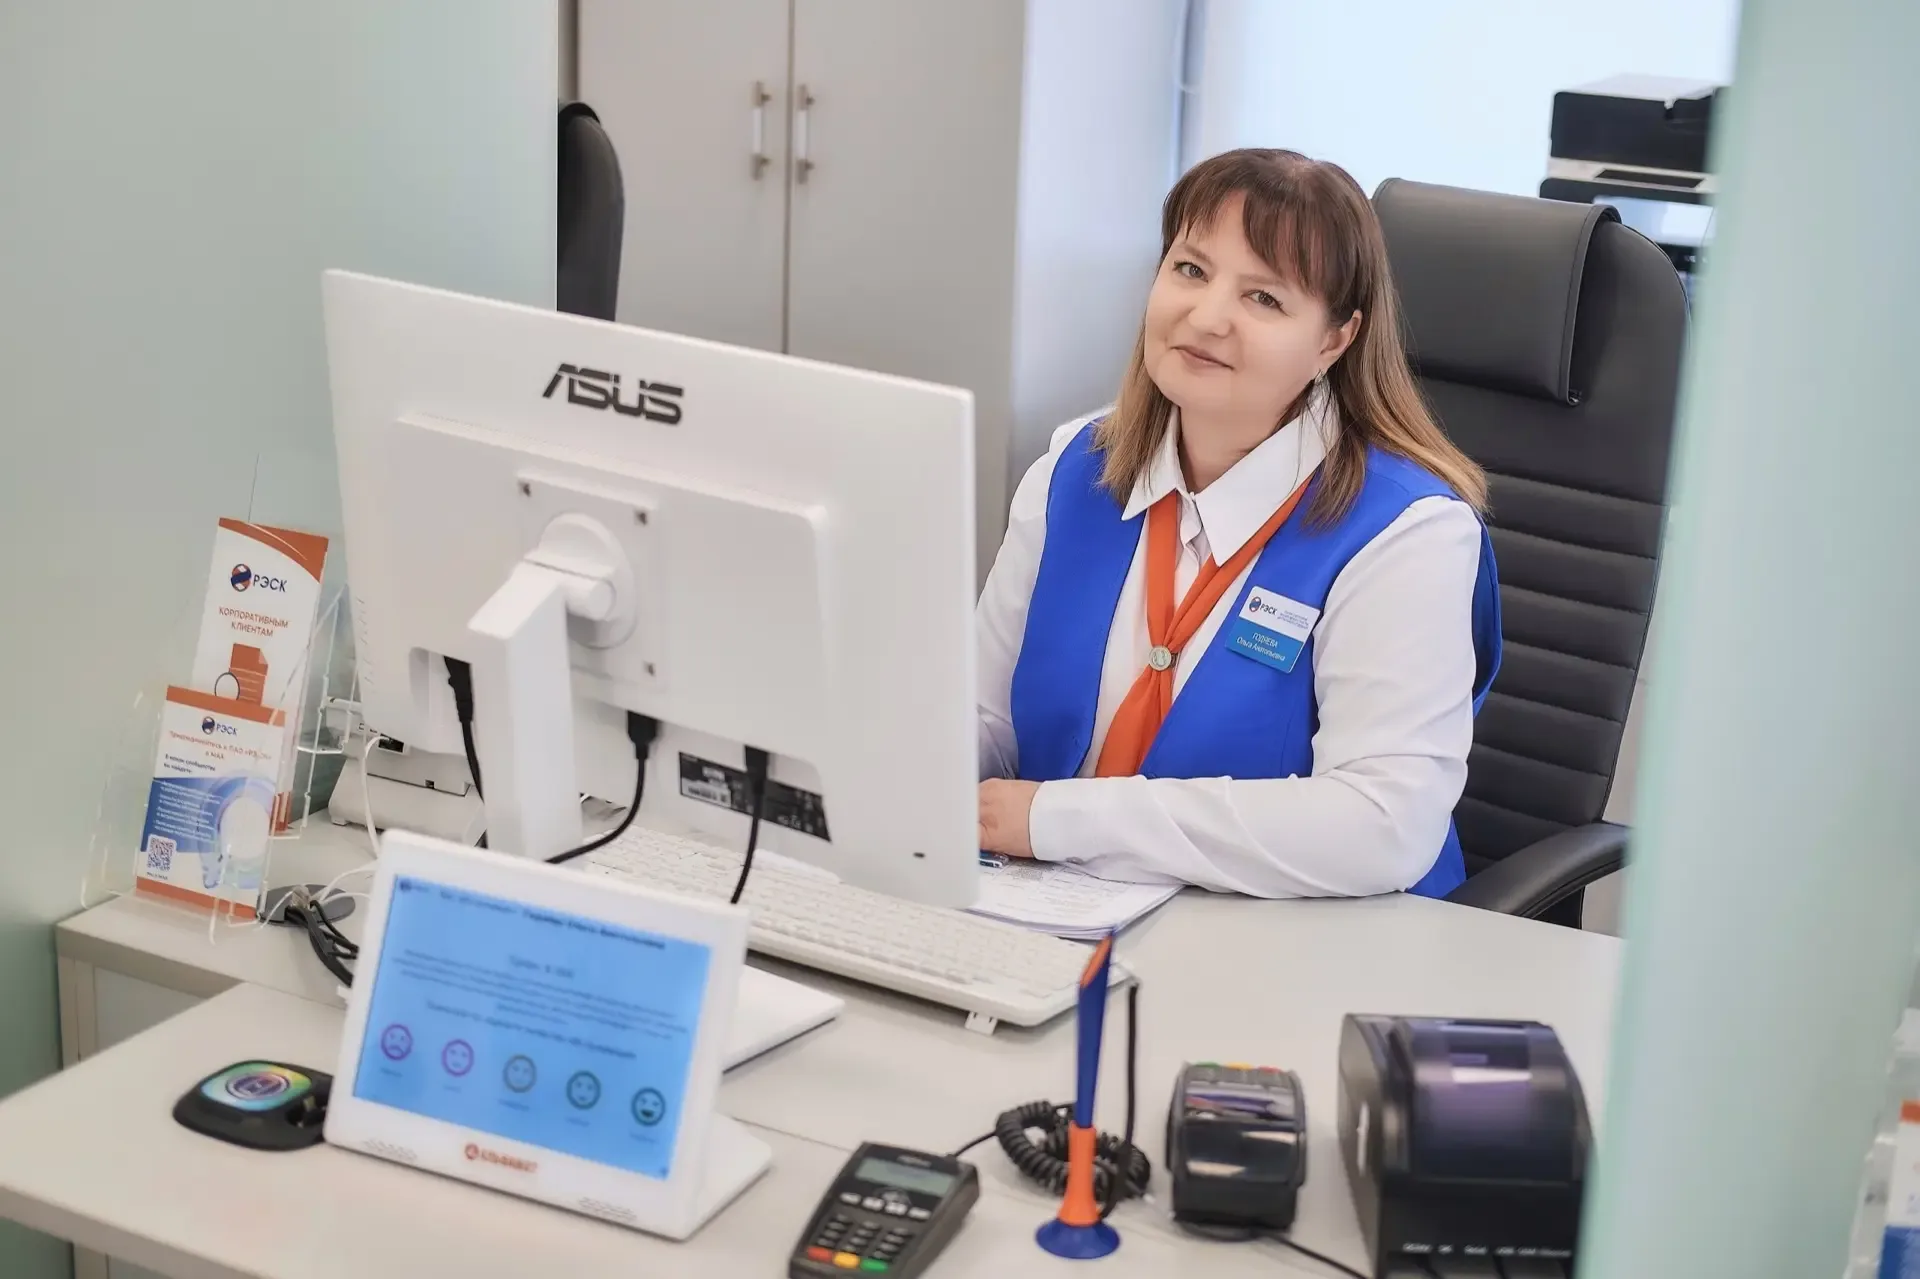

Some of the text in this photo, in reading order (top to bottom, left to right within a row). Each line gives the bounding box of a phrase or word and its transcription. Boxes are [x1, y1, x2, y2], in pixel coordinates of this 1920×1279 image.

[542, 363, 684, 425] ASUS
[253, 574, 287, 592] РЭСК
[219, 606, 289, 628] КОРПОРАТИВНЫМ
[1260, 603, 1277, 615] РЭСК
[231, 621, 273, 637] КЛИЕНТАМ
[216, 723, 238, 737] РЭСК
